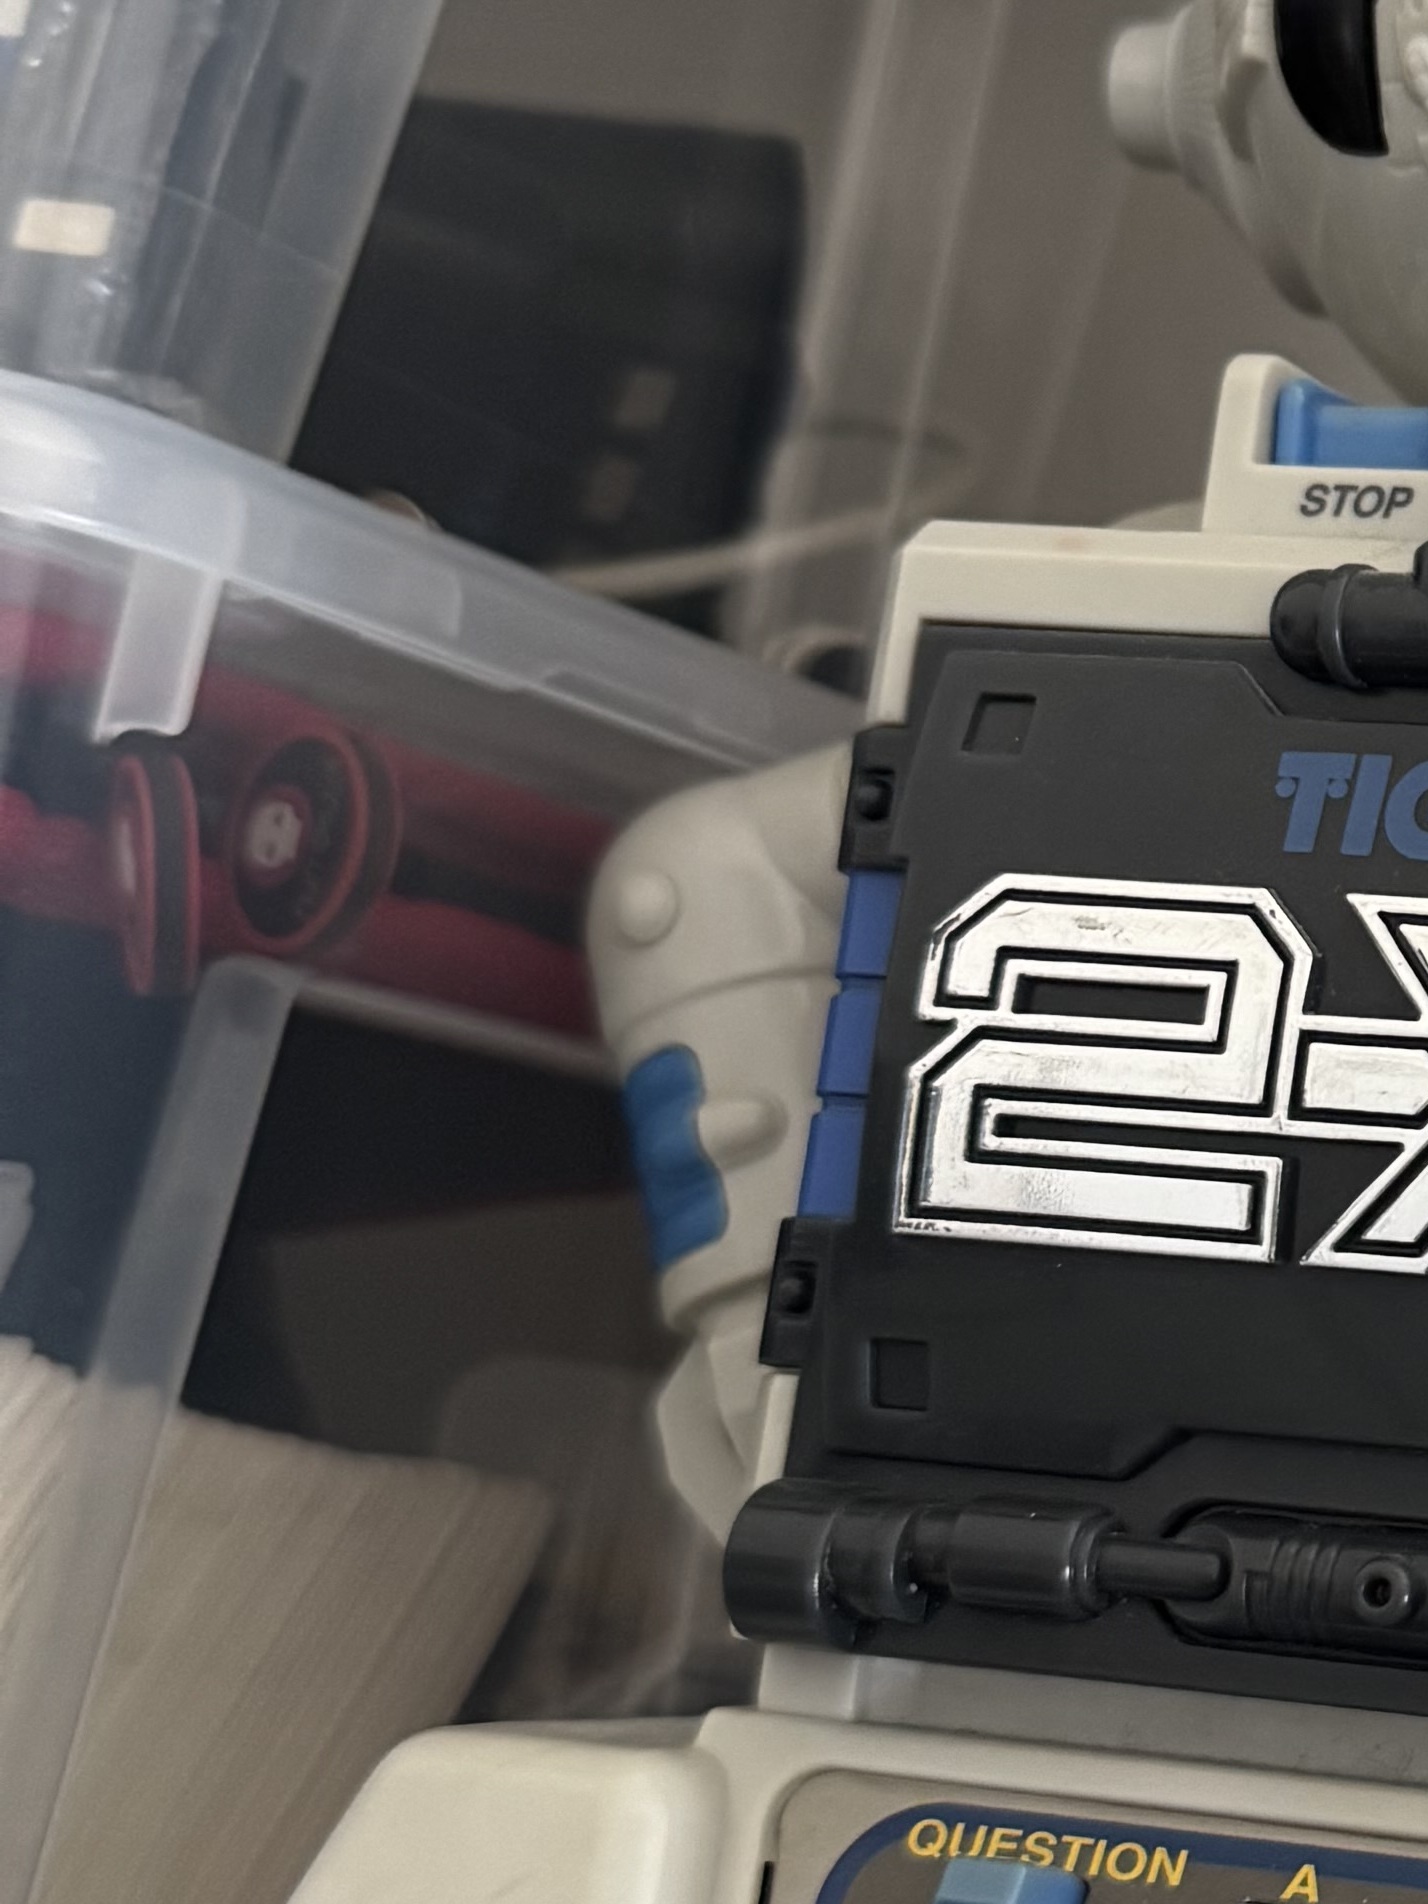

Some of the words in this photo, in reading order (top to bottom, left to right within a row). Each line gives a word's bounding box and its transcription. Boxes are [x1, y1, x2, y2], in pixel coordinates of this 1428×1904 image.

[1300, 484, 1415, 519] STOP
[906, 1818, 1189, 1887] QUESTION
[1280, 1863, 1321, 1904] A
